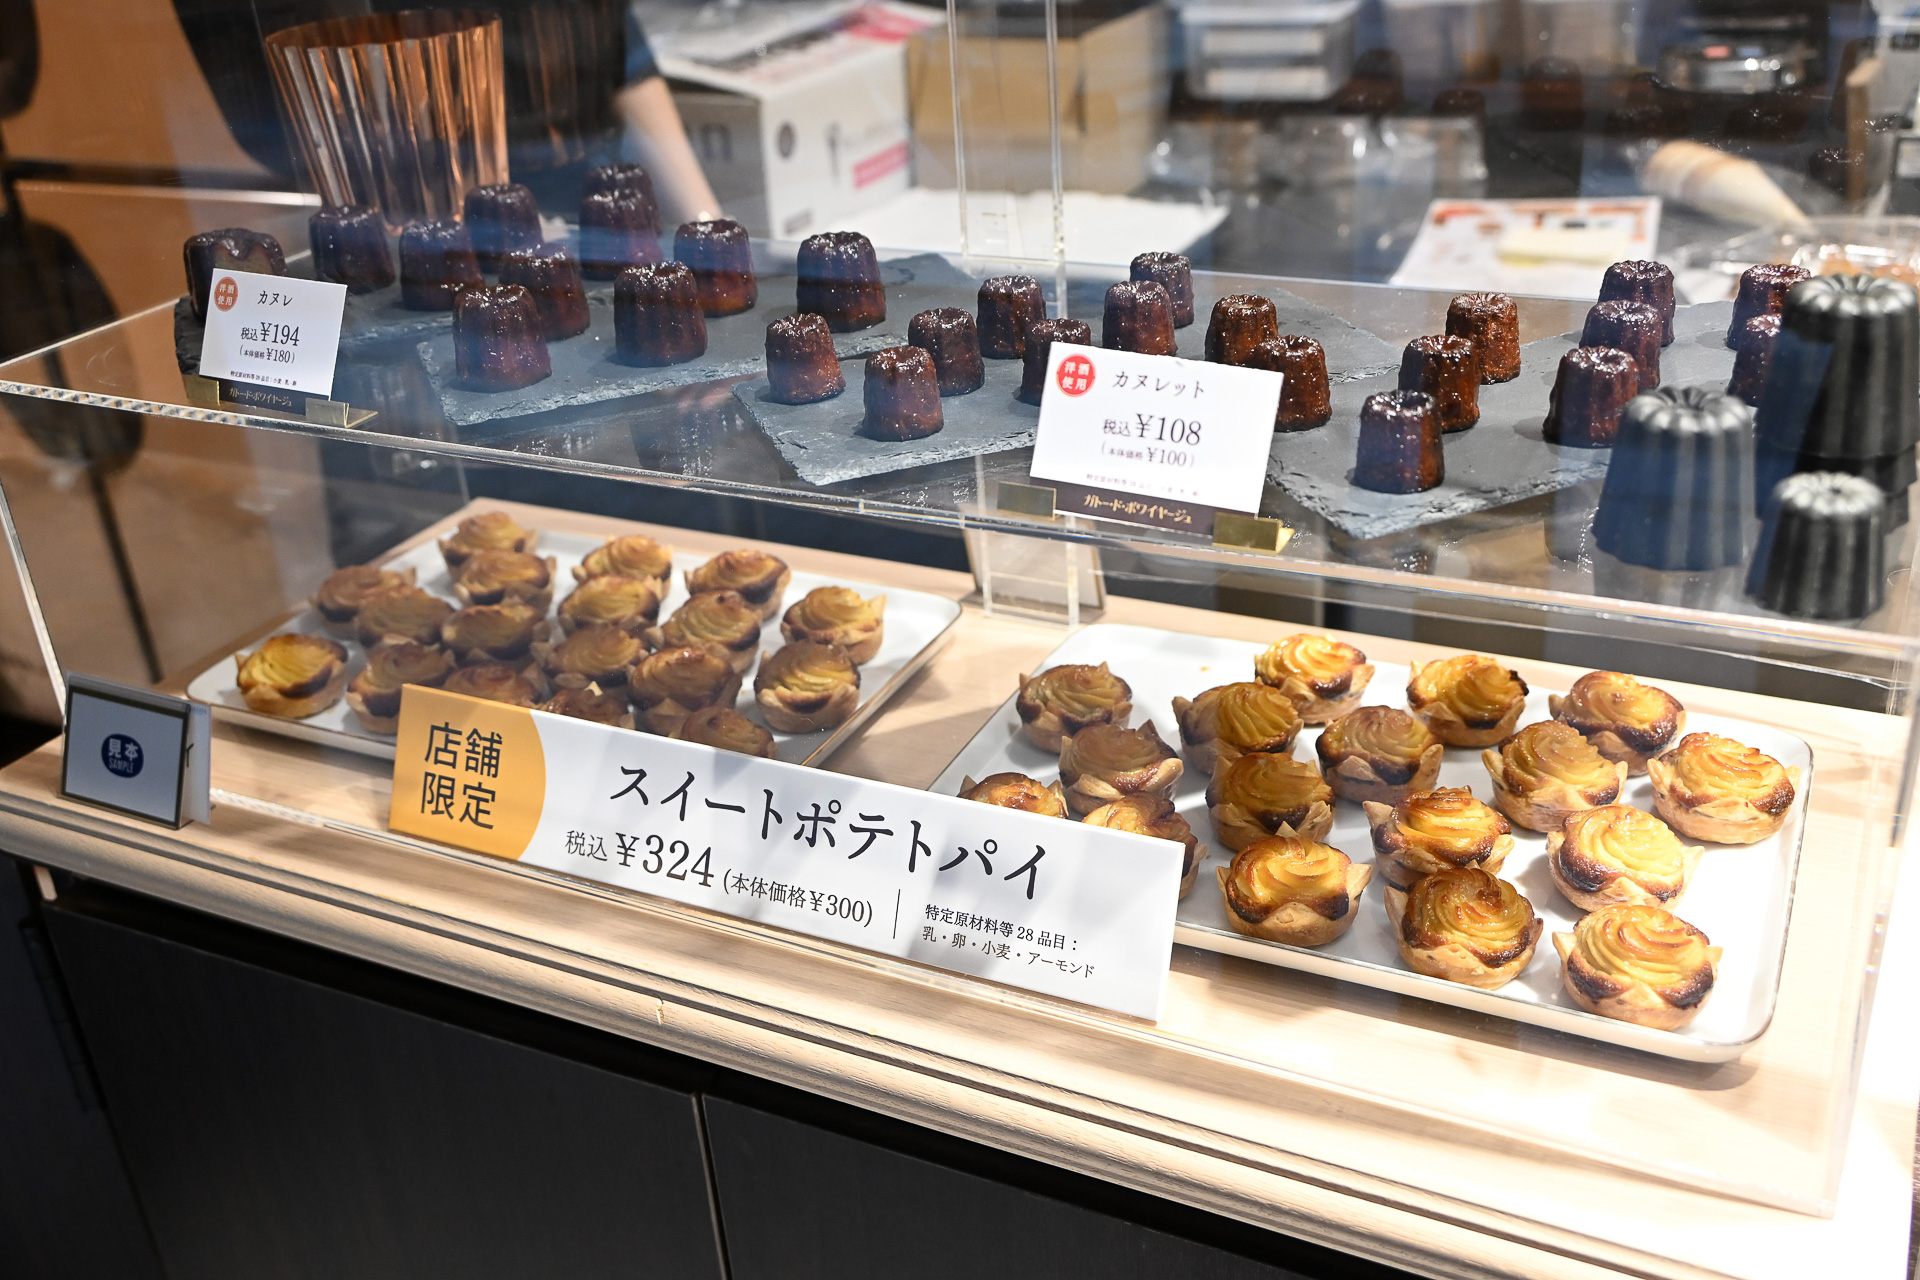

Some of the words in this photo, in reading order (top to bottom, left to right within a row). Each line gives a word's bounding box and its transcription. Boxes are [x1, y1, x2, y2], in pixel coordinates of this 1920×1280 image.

[219, 284, 235, 294] 洋酒
[257, 290, 293, 306] カヌレ
[217, 296, 233, 306] 使用
[1064, 361, 1091, 376] 洋酒
[1062, 376, 1088, 391] 使用
[1112, 371, 1204, 398] カヌレット
[108, 738, 139, 761] 見本
[424, 722, 503, 779] 店舗
[109, 757, 134, 774] SAMPLE
[421, 771, 496, 830] 限定
[610, 765, 1046, 900] スイートポテトパイ
[922, 925, 1095, 979] 乳・卵・小麦・アーモンド
